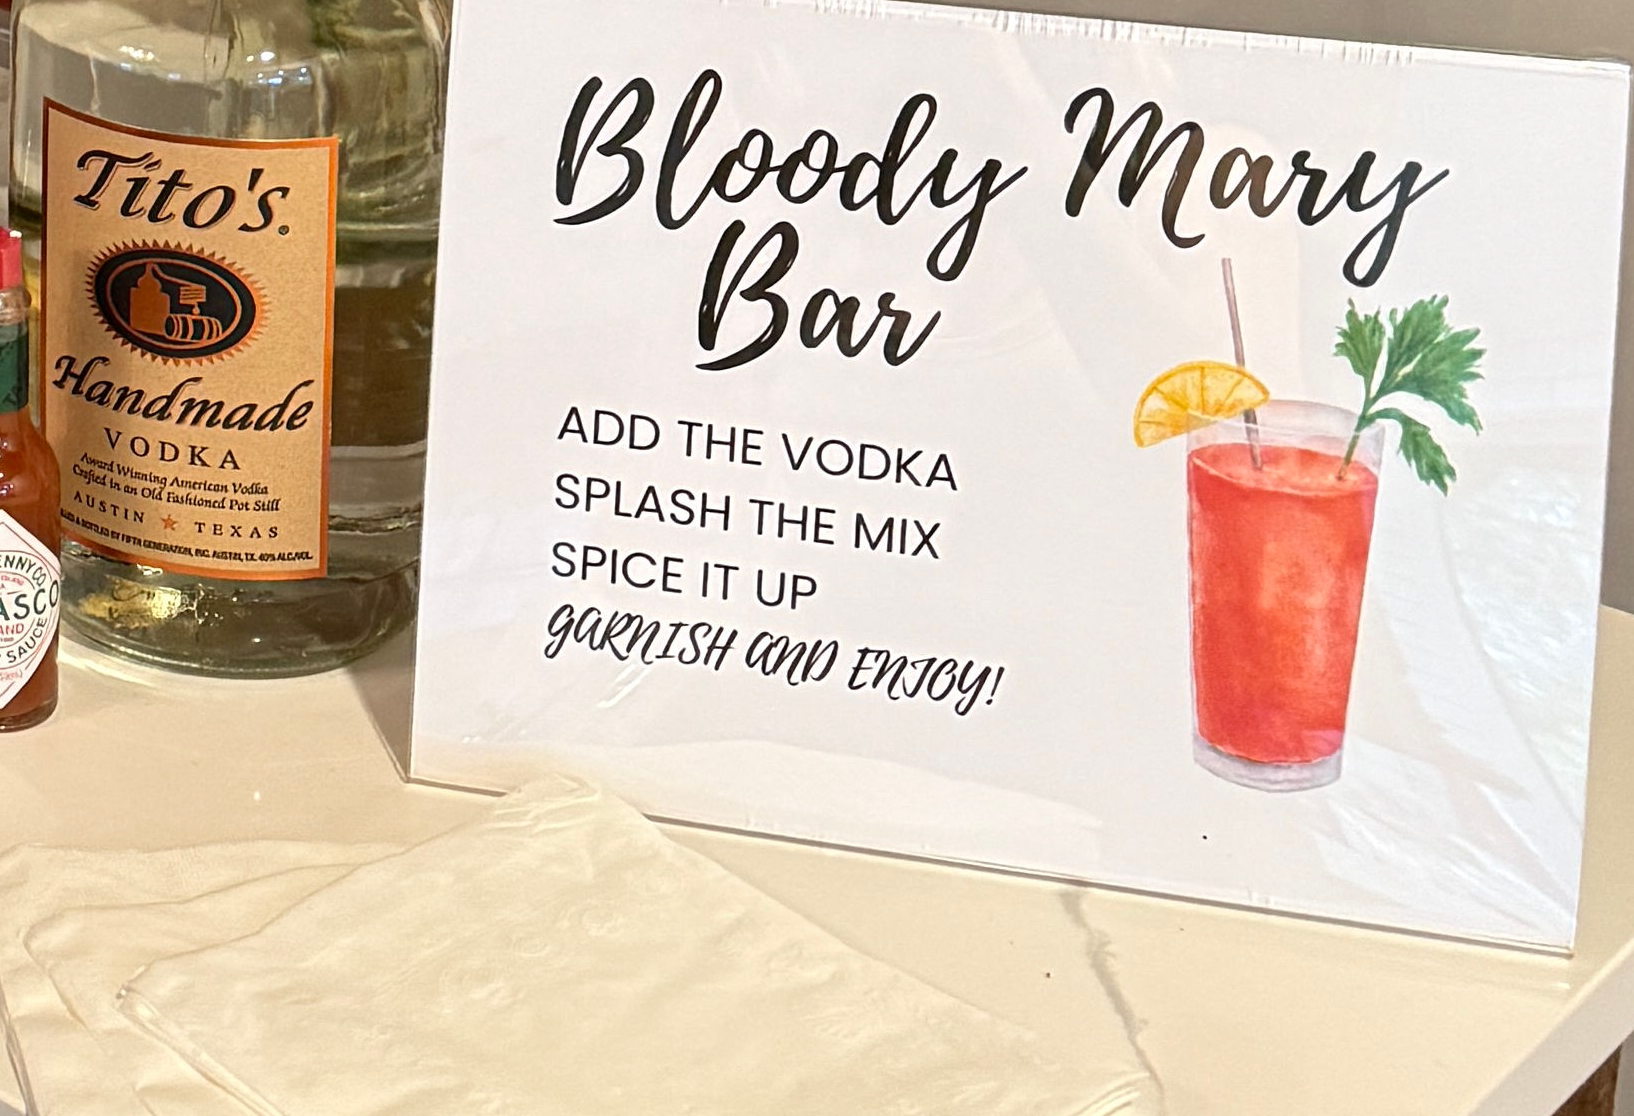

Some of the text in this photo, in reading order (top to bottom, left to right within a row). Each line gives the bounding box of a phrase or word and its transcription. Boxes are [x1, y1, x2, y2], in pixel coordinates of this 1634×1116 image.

[73, 150, 291, 233] Tito's
[553, 68, 1449, 288] Bloody Mary
[695, 219, 941, 371] Bar
[52, 355, 315, 431] Handmade
[80, 452, 269, 495] Award Winning American Vodka
[104, 427, 241, 470] VODKA
[557, 406, 958, 491] ADD THE VODKA
[72, 464, 108, 485] Crafted
[123, 484, 138, 496] an
[141, 486, 166, 501] Old
[166, 491, 226, 510] Fashioned
[229, 498, 251, 512] Pot
[253, 498, 282, 512] Still
[74, 490, 145, 523] AUSTIN
[194, 521, 279, 539] TEXAS
[555, 473, 941, 559] SPLASH THE MIX
[551, 541, 817, 610] SPICE IT UP
[7, 617, 48, 664] SAUCE
[847, 647, 1005, 716] ENJOY!
